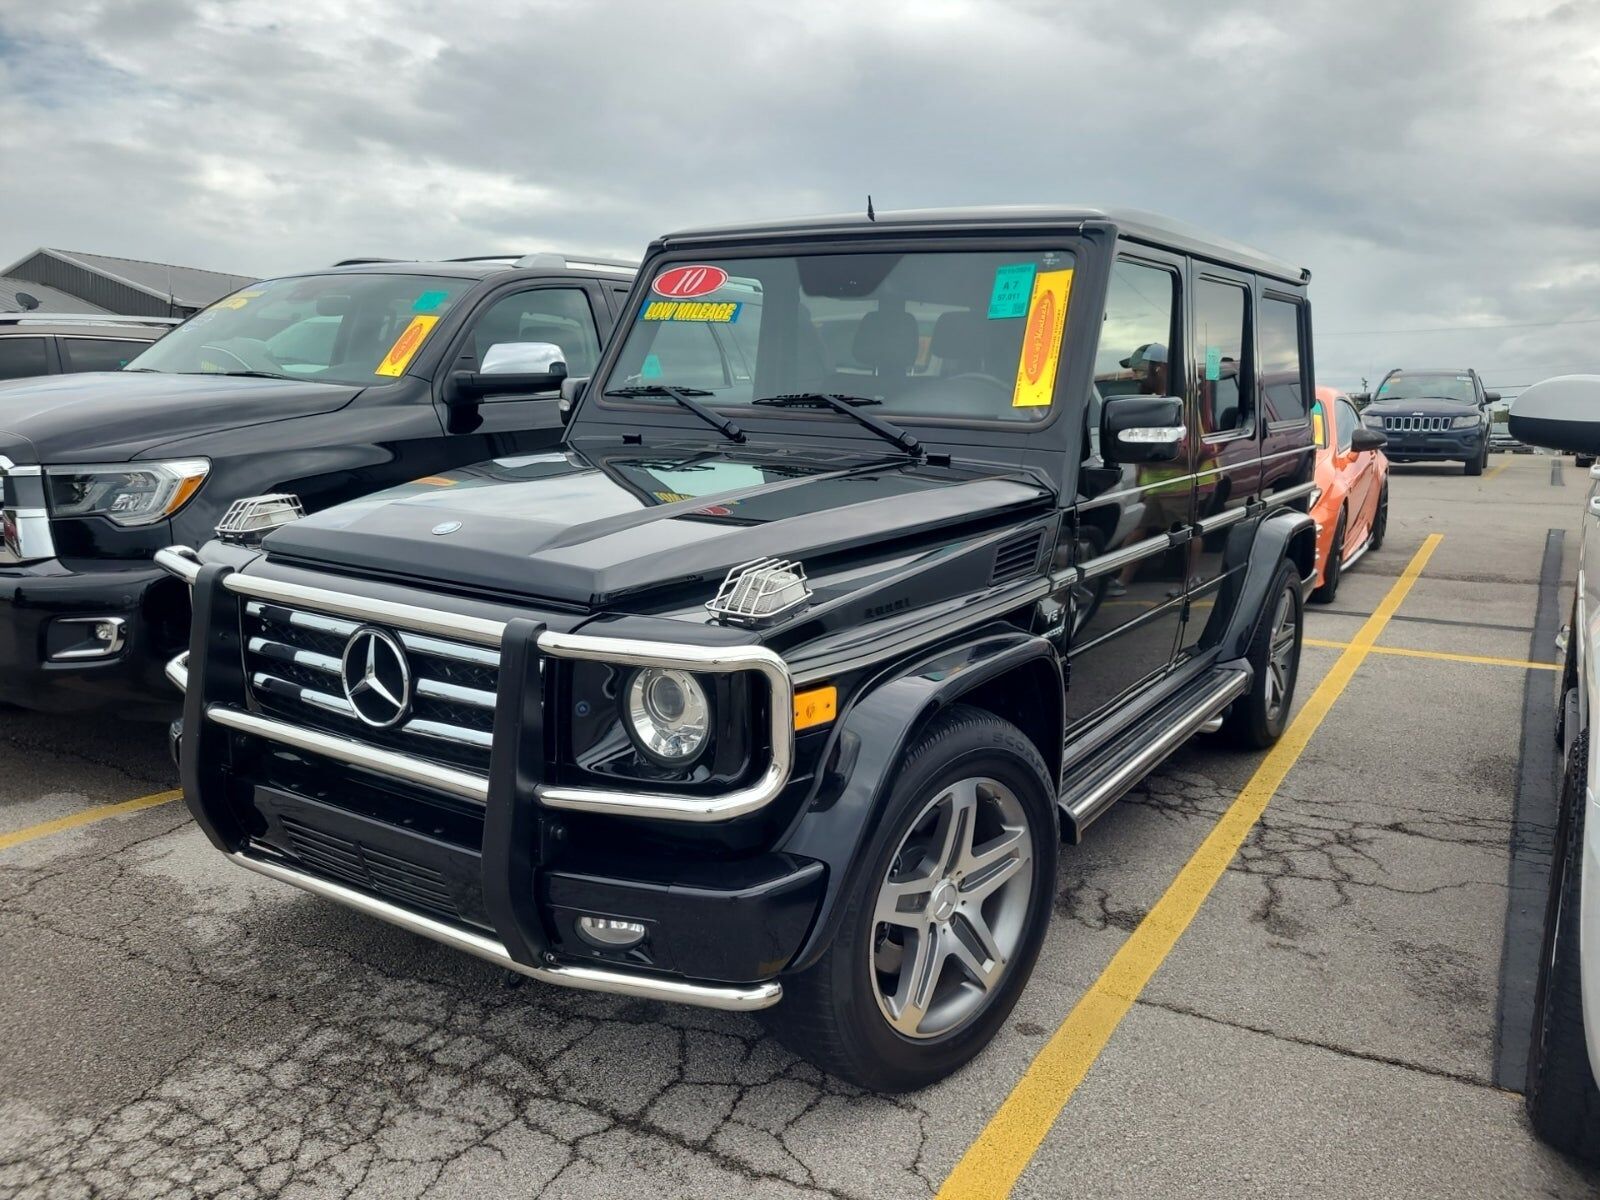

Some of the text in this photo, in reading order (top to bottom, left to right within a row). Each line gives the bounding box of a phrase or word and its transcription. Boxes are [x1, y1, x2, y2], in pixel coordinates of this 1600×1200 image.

[670, 268, 707, 294] 10
[643, 302, 737, 322] LOW MILEAGE
